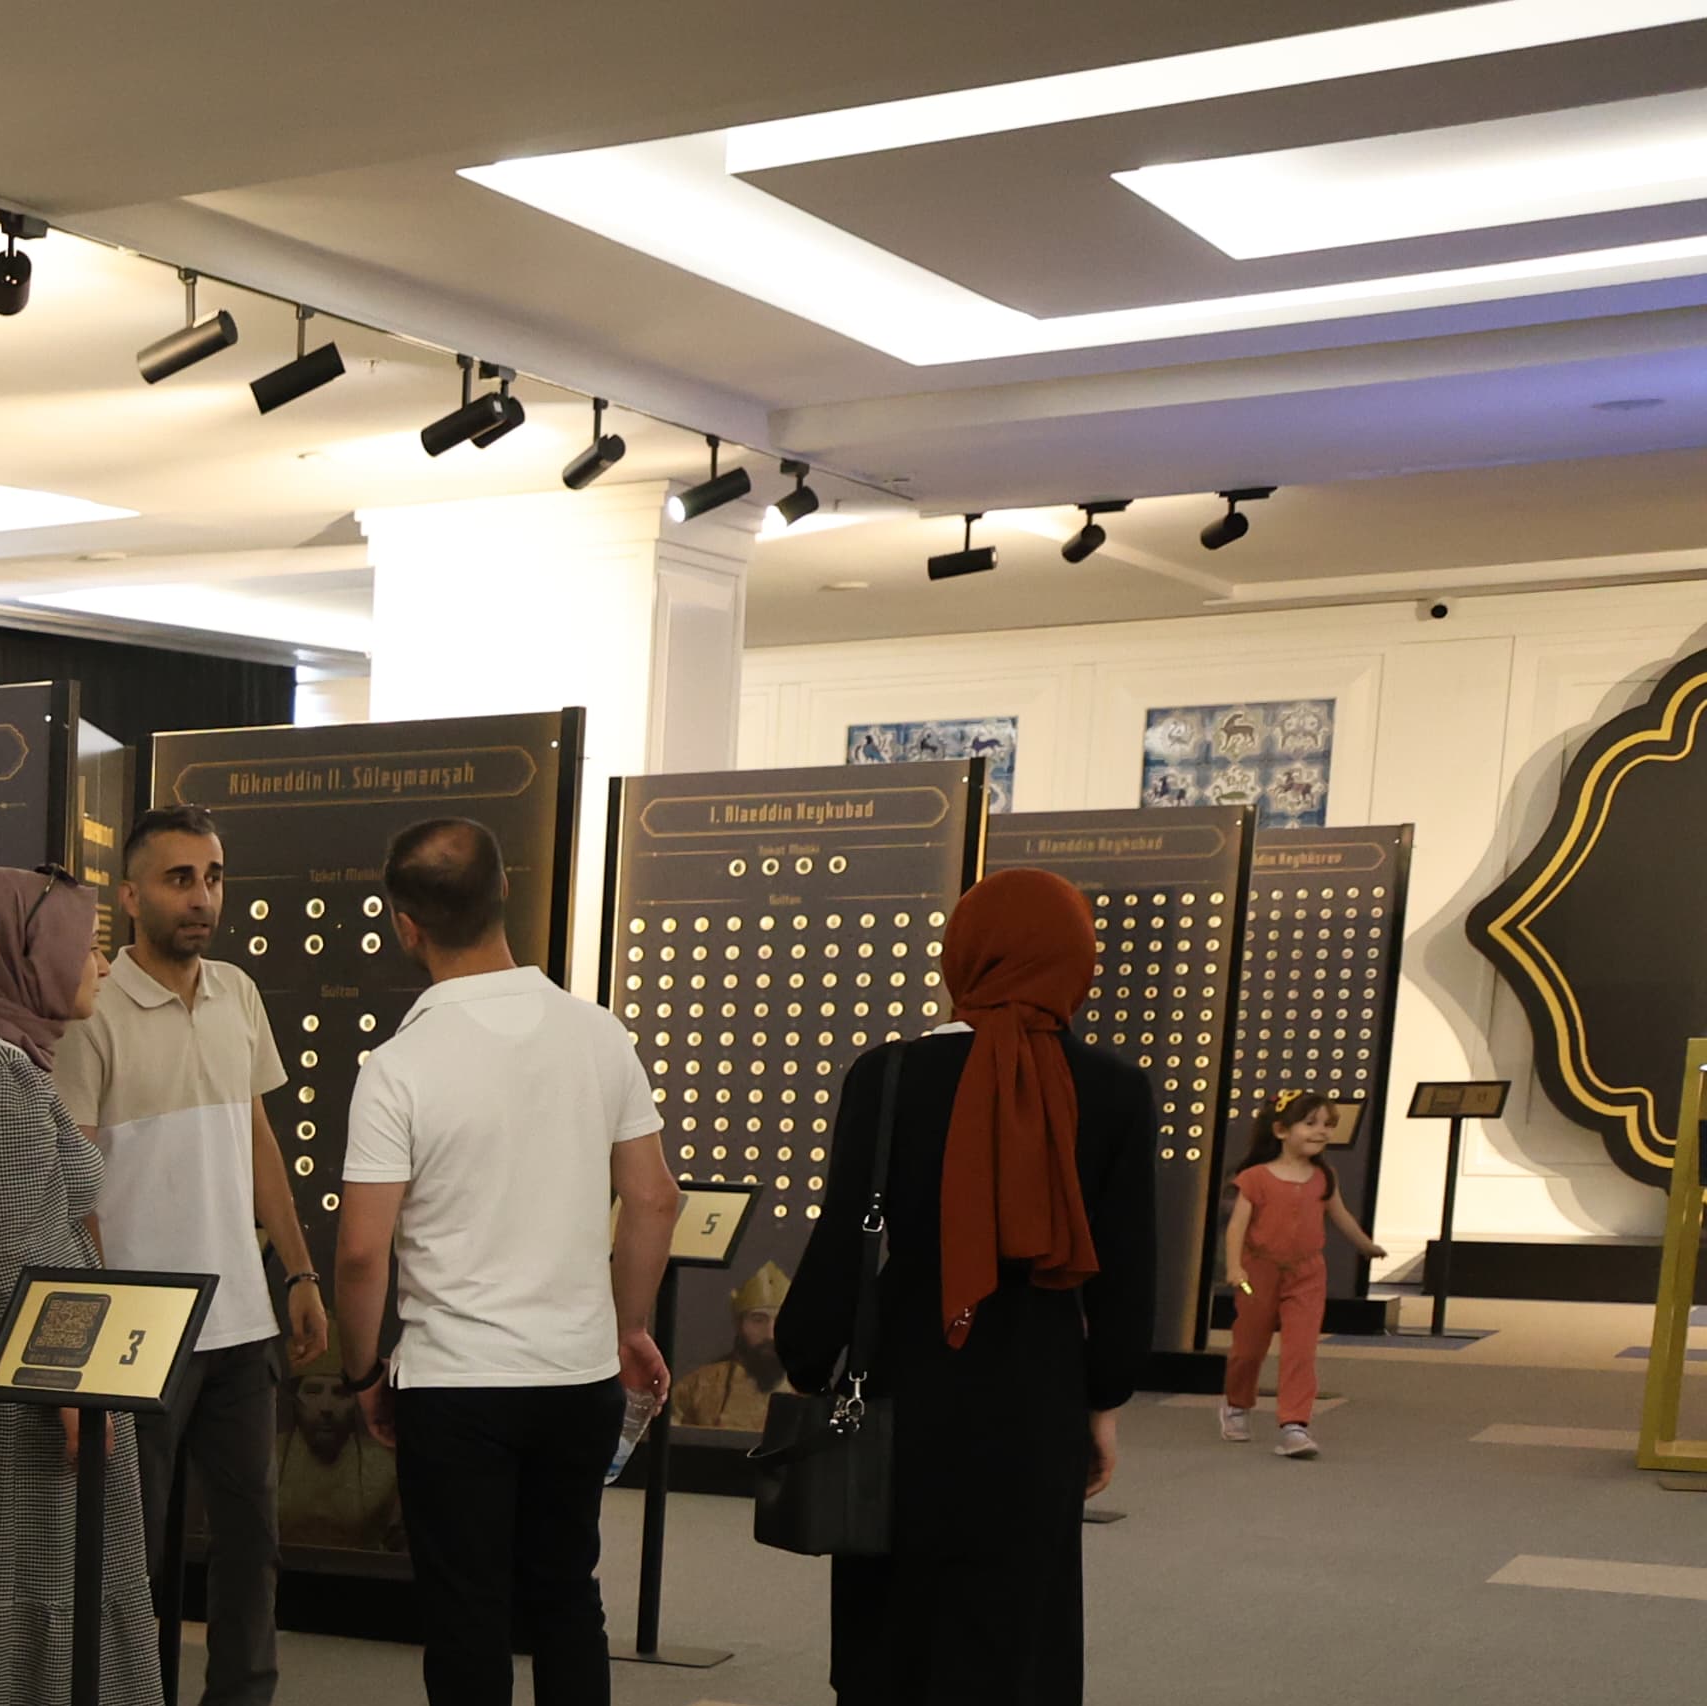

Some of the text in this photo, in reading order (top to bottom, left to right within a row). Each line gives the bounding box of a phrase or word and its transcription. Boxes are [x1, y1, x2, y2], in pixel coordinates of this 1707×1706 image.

[229, 761, 475, 796] Rükneddin II. Süleymanşah
[725, 804, 792, 823] Alaeddin
[797, 800, 874, 825] Keykubad
[701, 1213, 721, 1235] 5
[119, 1329, 146, 1365] 3
